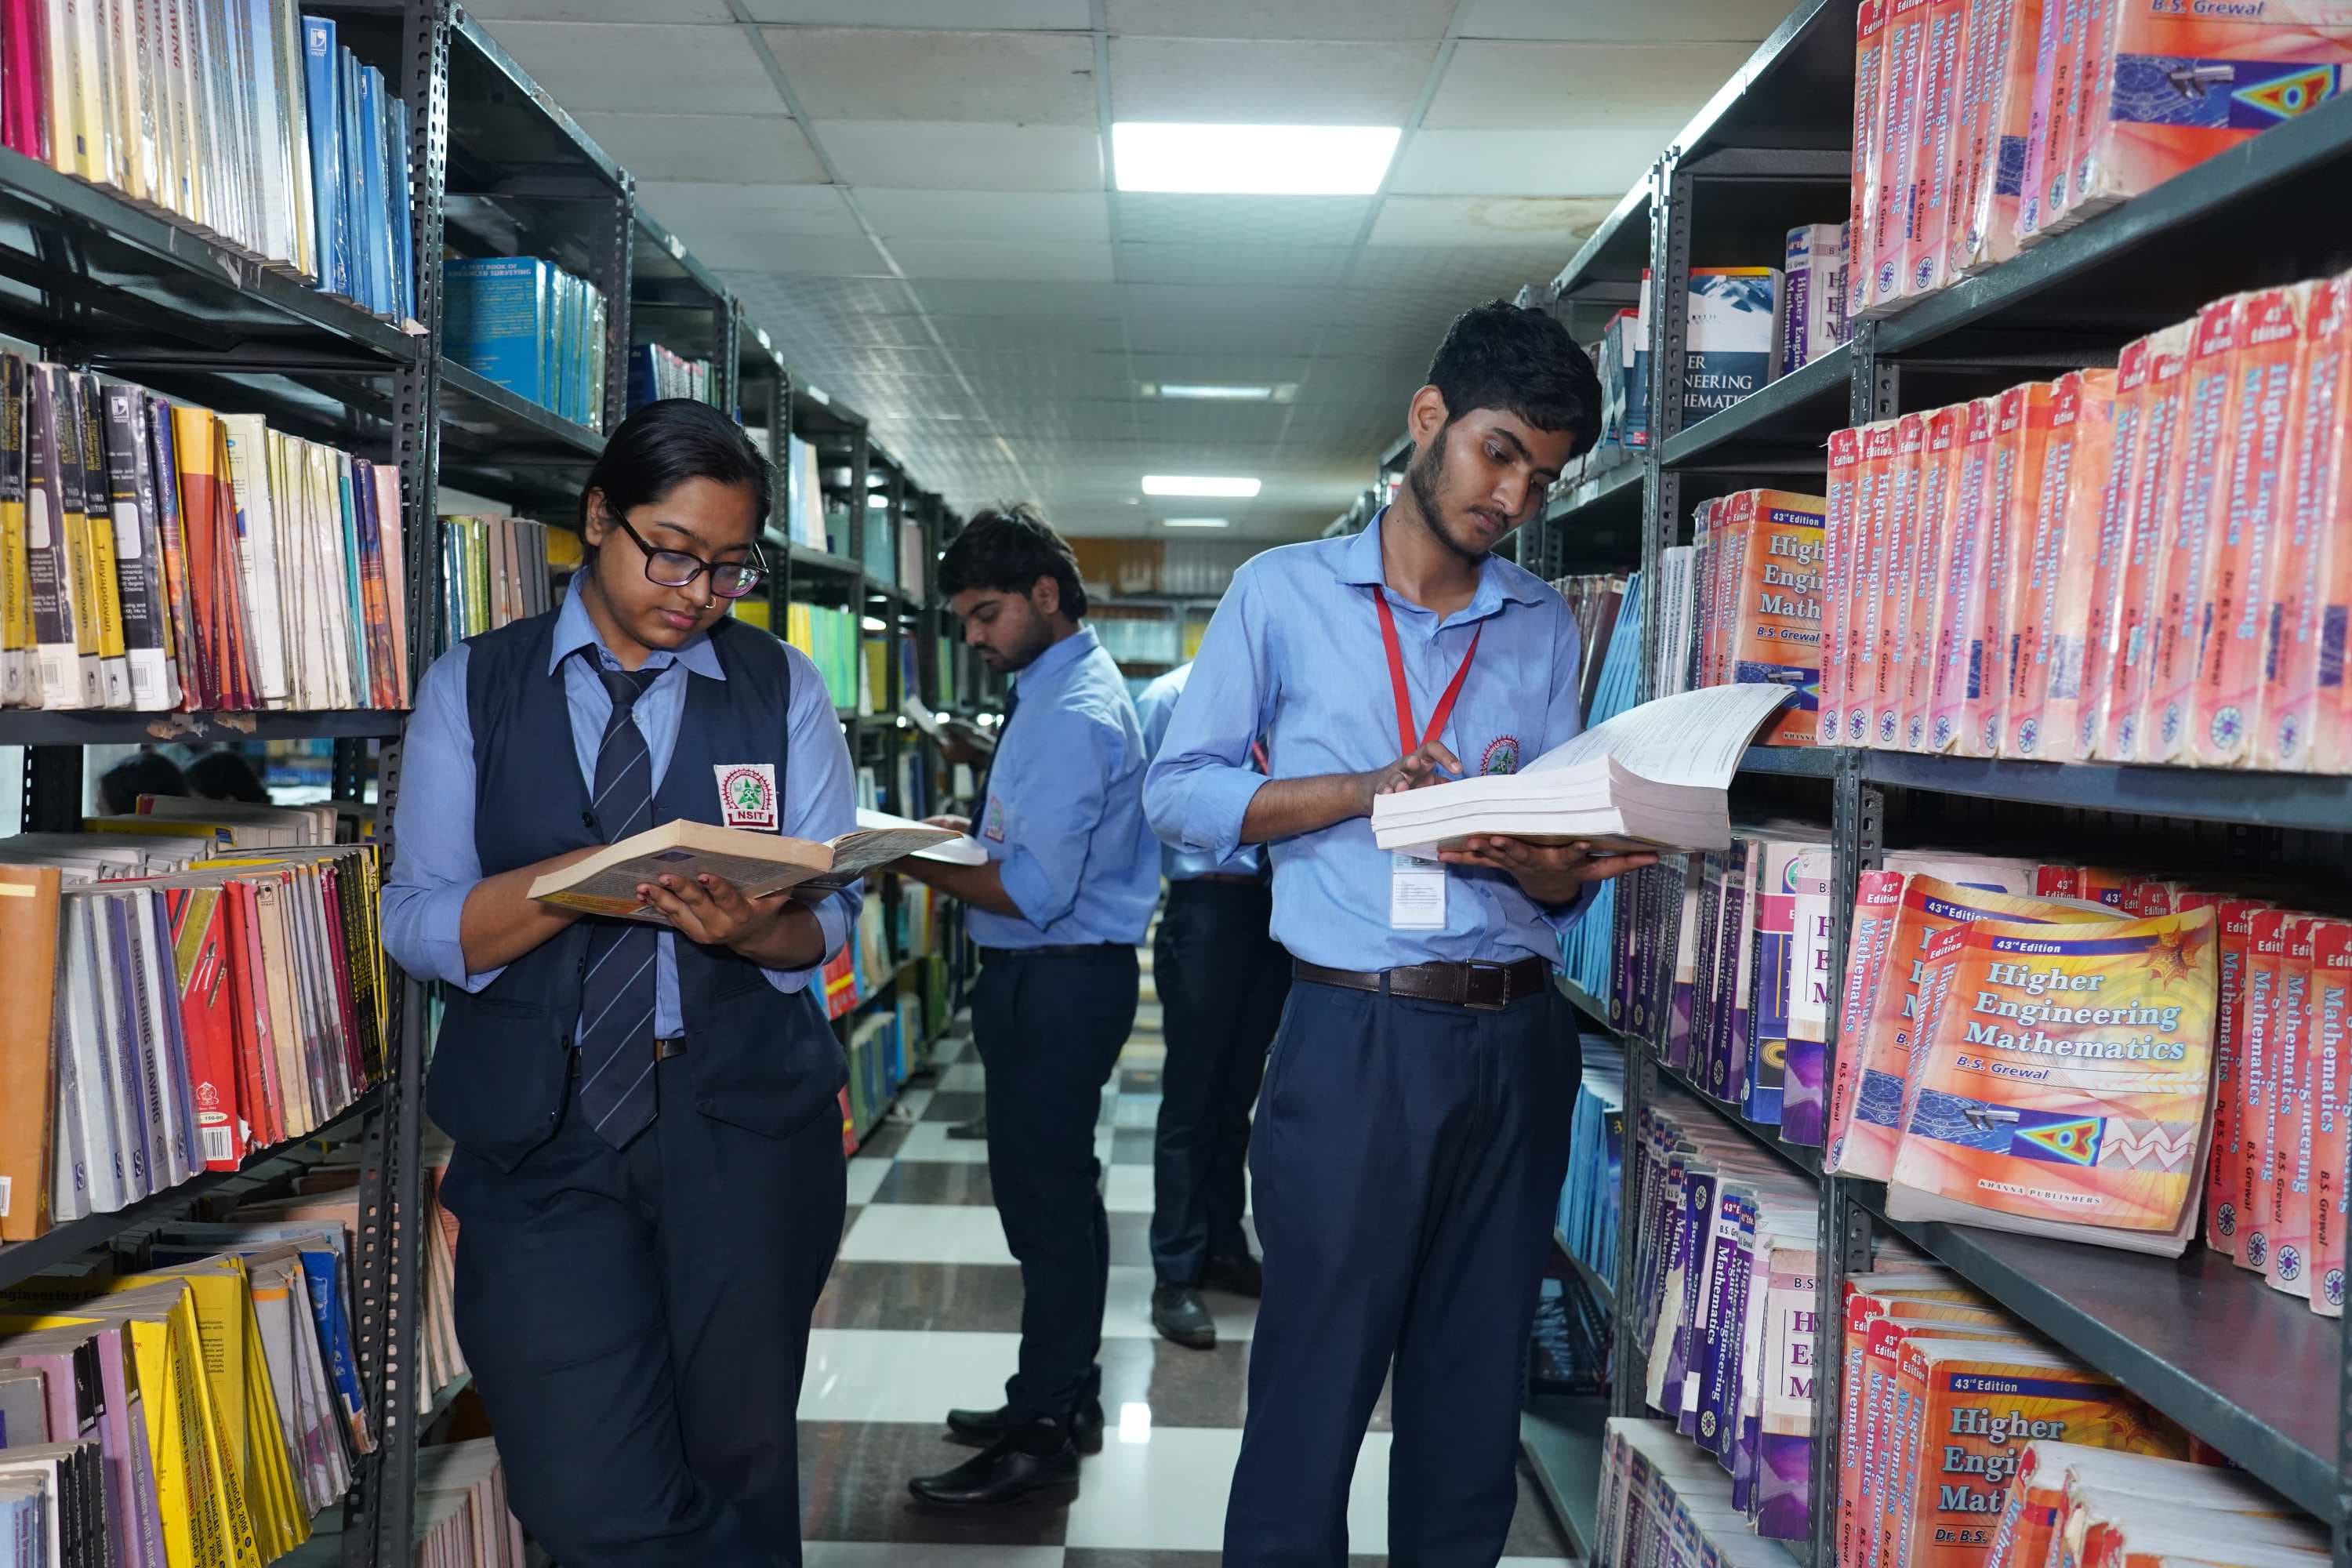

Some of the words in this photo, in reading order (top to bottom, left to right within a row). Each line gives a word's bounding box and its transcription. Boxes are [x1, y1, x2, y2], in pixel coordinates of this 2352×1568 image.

[2193, 0, 2265, 16] Grewal
[1904, 21, 1921, 90] Higher
[1943, 10, 1961, 81] Higher
[1857, 50, 1872, 172] Mathematics
[1886, 27, 1905, 153] Mathematics
[1922, 18, 1945, 147] Mathematics
[1891, 96, 1914, 215] Engineering
[1928, 87, 1953, 209] Engineering
[2049, 114, 2062, 161] Grewal
[1969, 162, 1980, 205] Grewal
[1850, 227, 1859, 265] Grewal
[1878, 208, 1887, 248] Grewal
[1915, 201, 1925, 242] Grewal
[1783, 278, 1795, 364] Mathematics
[1793, 276, 1807, 321] Higher
[2201, 373, 2227, 465] Higher
[2260, 363, 2289, 461] Higher
[1834, 455, 1855, 466] Edition
[1866, 446, 1892, 458] Edition
[1900, 441, 1921, 452] Edition
[2178, 378, 2210, 549] Mathematics
[2228, 366, 2264, 546] Mathematics
[2294, 361, 2325, 546] Mathematics
[1842, 481, 1853, 546] Higher
[1873, 472, 1891, 540] Higher
[1907, 469, 1919, 537] Higher
[1968, 459, 1984, 532] Higher
[2054, 443, 2072, 520] Higher
[2099, 412, 2130, 568] Mathematics
[2133, 399, 2166, 565] Mathematics
[1768, 535, 1825, 565] High
[1773, 512, 1789, 521] 43rd
[1790, 515, 1820, 526] Edition
[1826, 482, 1842, 603] Mathematics
[1856, 475, 1874, 598] Mathematics
[1887, 470, 1907, 597] Mathematics
[1918, 467, 1939, 597] Mathematics
[1949, 463, 1972, 596] Mathematics
[1990, 451, 2008, 590] Mathematics
[2032, 446, 2058, 590] Mathematics
[2237, 470, 2277, 641] Engineering
[98, 558, 111, 633] Jeyapoovan
[1860, 546, 1882, 664] Engineering
[1893, 544, 1914, 663] Engineering
[1949, 539, 1974, 666] Engineering
[2035, 528, 2063, 665] Engineering
[1756, 626, 1777, 638] B.S.
[1780, 630, 1820, 642] Grewal
[1879, 652, 1889, 693] Grewal
[2019, 652, 2031, 699] Grewal
[738, 811, 764, 820] NSIT
[1867, 894, 1899, 904] Edition
[1881, 882, 1898, 893] 43rd
[1928, 902, 1948, 913] 43rd
[2143, 905, 2167, 916] Edition
[1718, 896, 1733, 995] Mathematics
[1730, 898, 1741, 952] Higher
[1871, 917, 1892, 979] Higher
[1929, 942, 1962, 960] Edition
[1942, 931, 1961, 946] 43rd
[1996, 940, 2020, 949] 43rd
[2019, 942, 2061, 953] Edition
[1639, 919, 1653, 996] Engineering
[1844, 918, 1878, 1033] Mathematics
[1931, 961, 1958, 1018] Higher
[1985, 961, 2105, 996] Higher
[132, 938, 153, 1045] ENGINEERING
[144, 1048, 161, 1124] DRAWING
[1720, 956, 1737, 1049] Engineering
[1907, 968, 1937, 1075] Mathematics
[1972, 990, 2183, 1033] Engineering
[2219, 952, 2240, 1082] Mathematics
[1956, 1055, 1984, 1071] B.S.
[1991, 1063, 2050, 1080] Grewal
[1962, 1020, 2187, 1062] Mathematics
[2249, 970, 2272, 1106] Mathematics
[2280, 974, 2305, 1115] Mathematics
[2320, 986, 2347, 1134] Mathematics
[1833, 1083, 1844, 1122] Grewal
[1839, 1062, 1848, 1079] B.S.
[2216, 1119, 2225, 1142] B.S.
[2217, 1099, 2226, 1117] Dr.
[2214, 1144, 2224, 1187] Grewal
[2246, 1141, 2256, 1163] B.S.
[2277, 1151, 2287, 1173] B.S.
[2320, 1171, 2330, 1193] B.S.
[1979, 1179, 2024, 1194] KHANNA
[2029, 1189, 2102, 1204] PUBLISHERS
[2244, 1167, 2255, 1211] Grewal
[2274, 1178, 2285, 1224] Grewal
[1719, 1225, 1730, 1235] B.S.
[2318, 1198, 2329, 1247] Grewal
[1707, 1244, 1730, 1345] Mathematics
[1739, 1260, 1751, 1316] Higher
[1711, 1308, 1733, 1403] Engineering
[1728, 1321, 1744, 1417] Engineering
[1884, 1334, 1898, 1346] 43rd
[1846, 1346, 1864, 1468] Mathematics
[1881, 1376, 1896, 1444] Higher
[1955, 1378, 1976, 1390] 43rd
[1977, 1380, 2018, 1393] Edition
[175, 1359, 183, 1399] Exercise
[179, 1401, 188, 1446] Workbook
[184, 1465, 196, 1517] BEGINNING
[1863, 1370, 1883, 1497] Mathematics
[1887, 1388, 1911, 1516] Mathematics
[1907, 1396, 1922, 1468] Higher
[1949, 1407, 2065, 1444] Higher
[219, 1426, 234, 1472] ADVANCED
[229, 1472, 243, 1512] AutoCAD
[238, 1511, 250, 1534] 2006
[225, 1483, 236, 1521] AutoCAD
[1844, 1499, 1853, 1520] B.S.
[1868, 1450, 1890, 1568] Engineering
[204, 1501, 213, 1541] AutoCAD
[209, 1493, 220, 1533] AutoCAD
[216, 1534, 224, 1557] 2006
[1842, 1522, 1851, 1564] Grewal
[1883, 1530, 1892, 1547] Dr.
[1934, 1528, 1955, 1542] Dr.
[1960, 1530, 1988, 1544] B.S.
